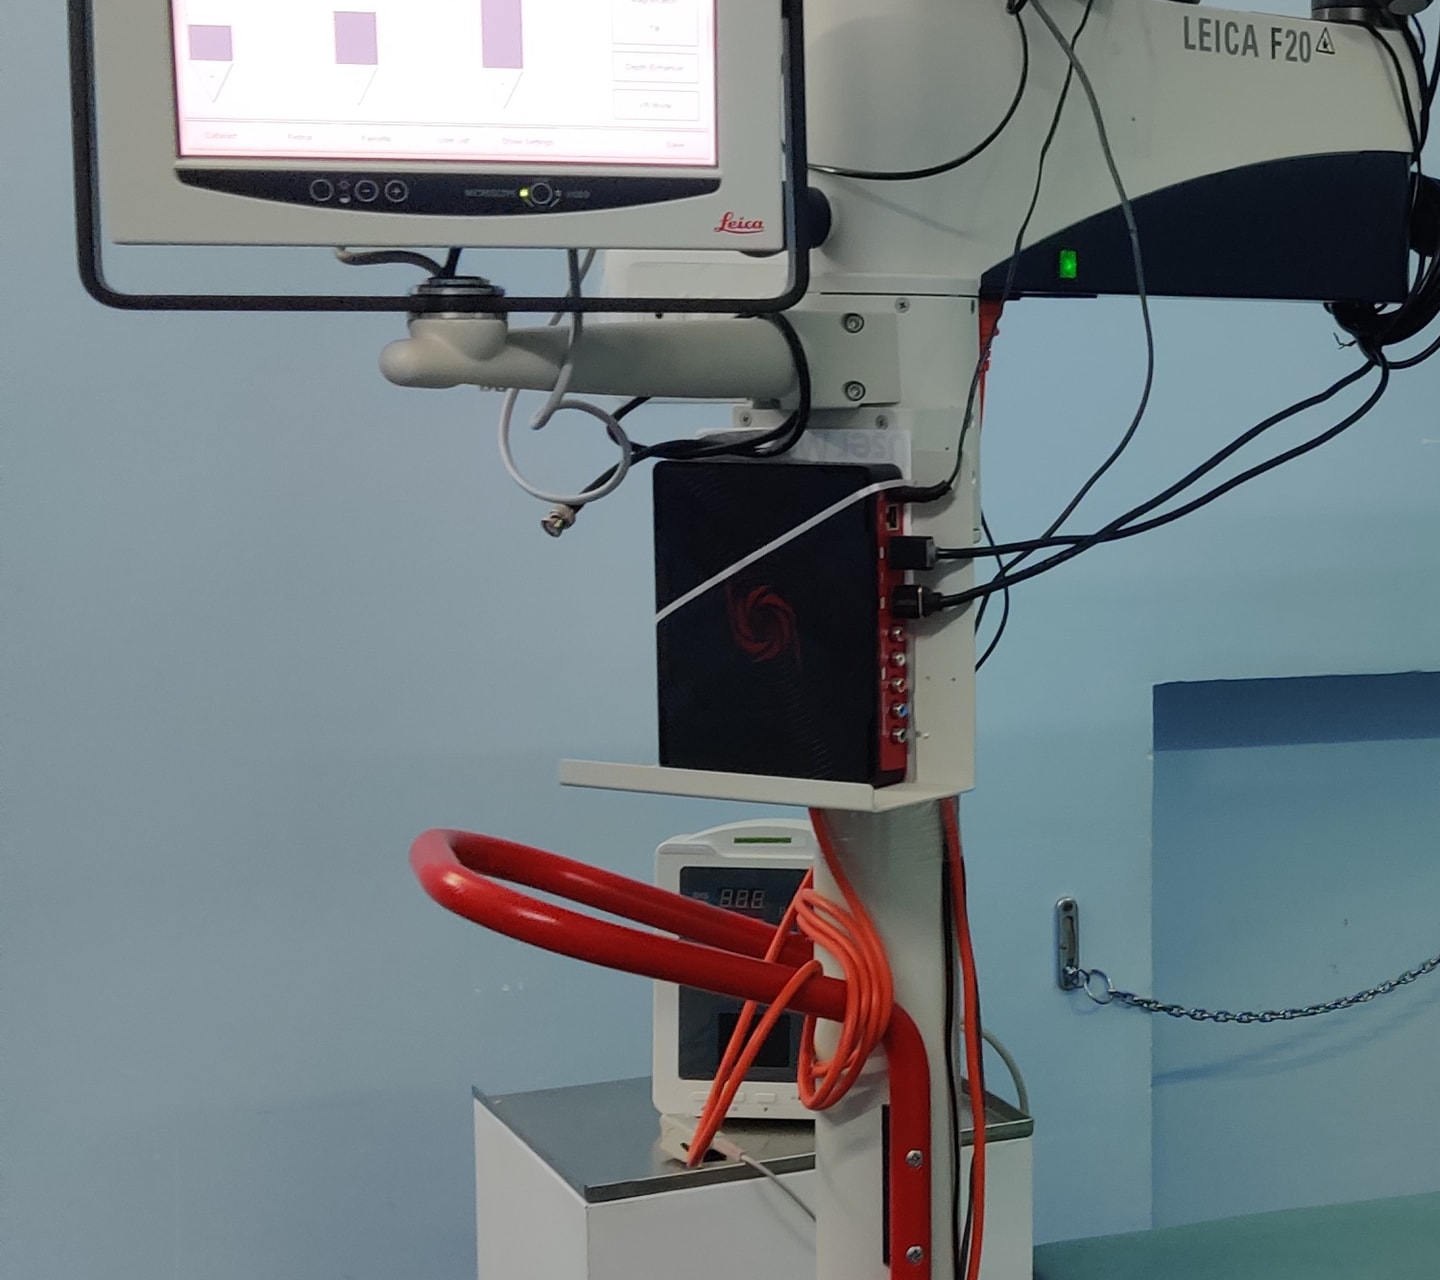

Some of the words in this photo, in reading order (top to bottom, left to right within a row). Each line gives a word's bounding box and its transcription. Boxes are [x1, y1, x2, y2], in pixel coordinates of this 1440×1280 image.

[1183, 15, 1260, 58] LEICA
[1271, 26, 1312, 64] F20
[714, 211, 765, 234] Leica
